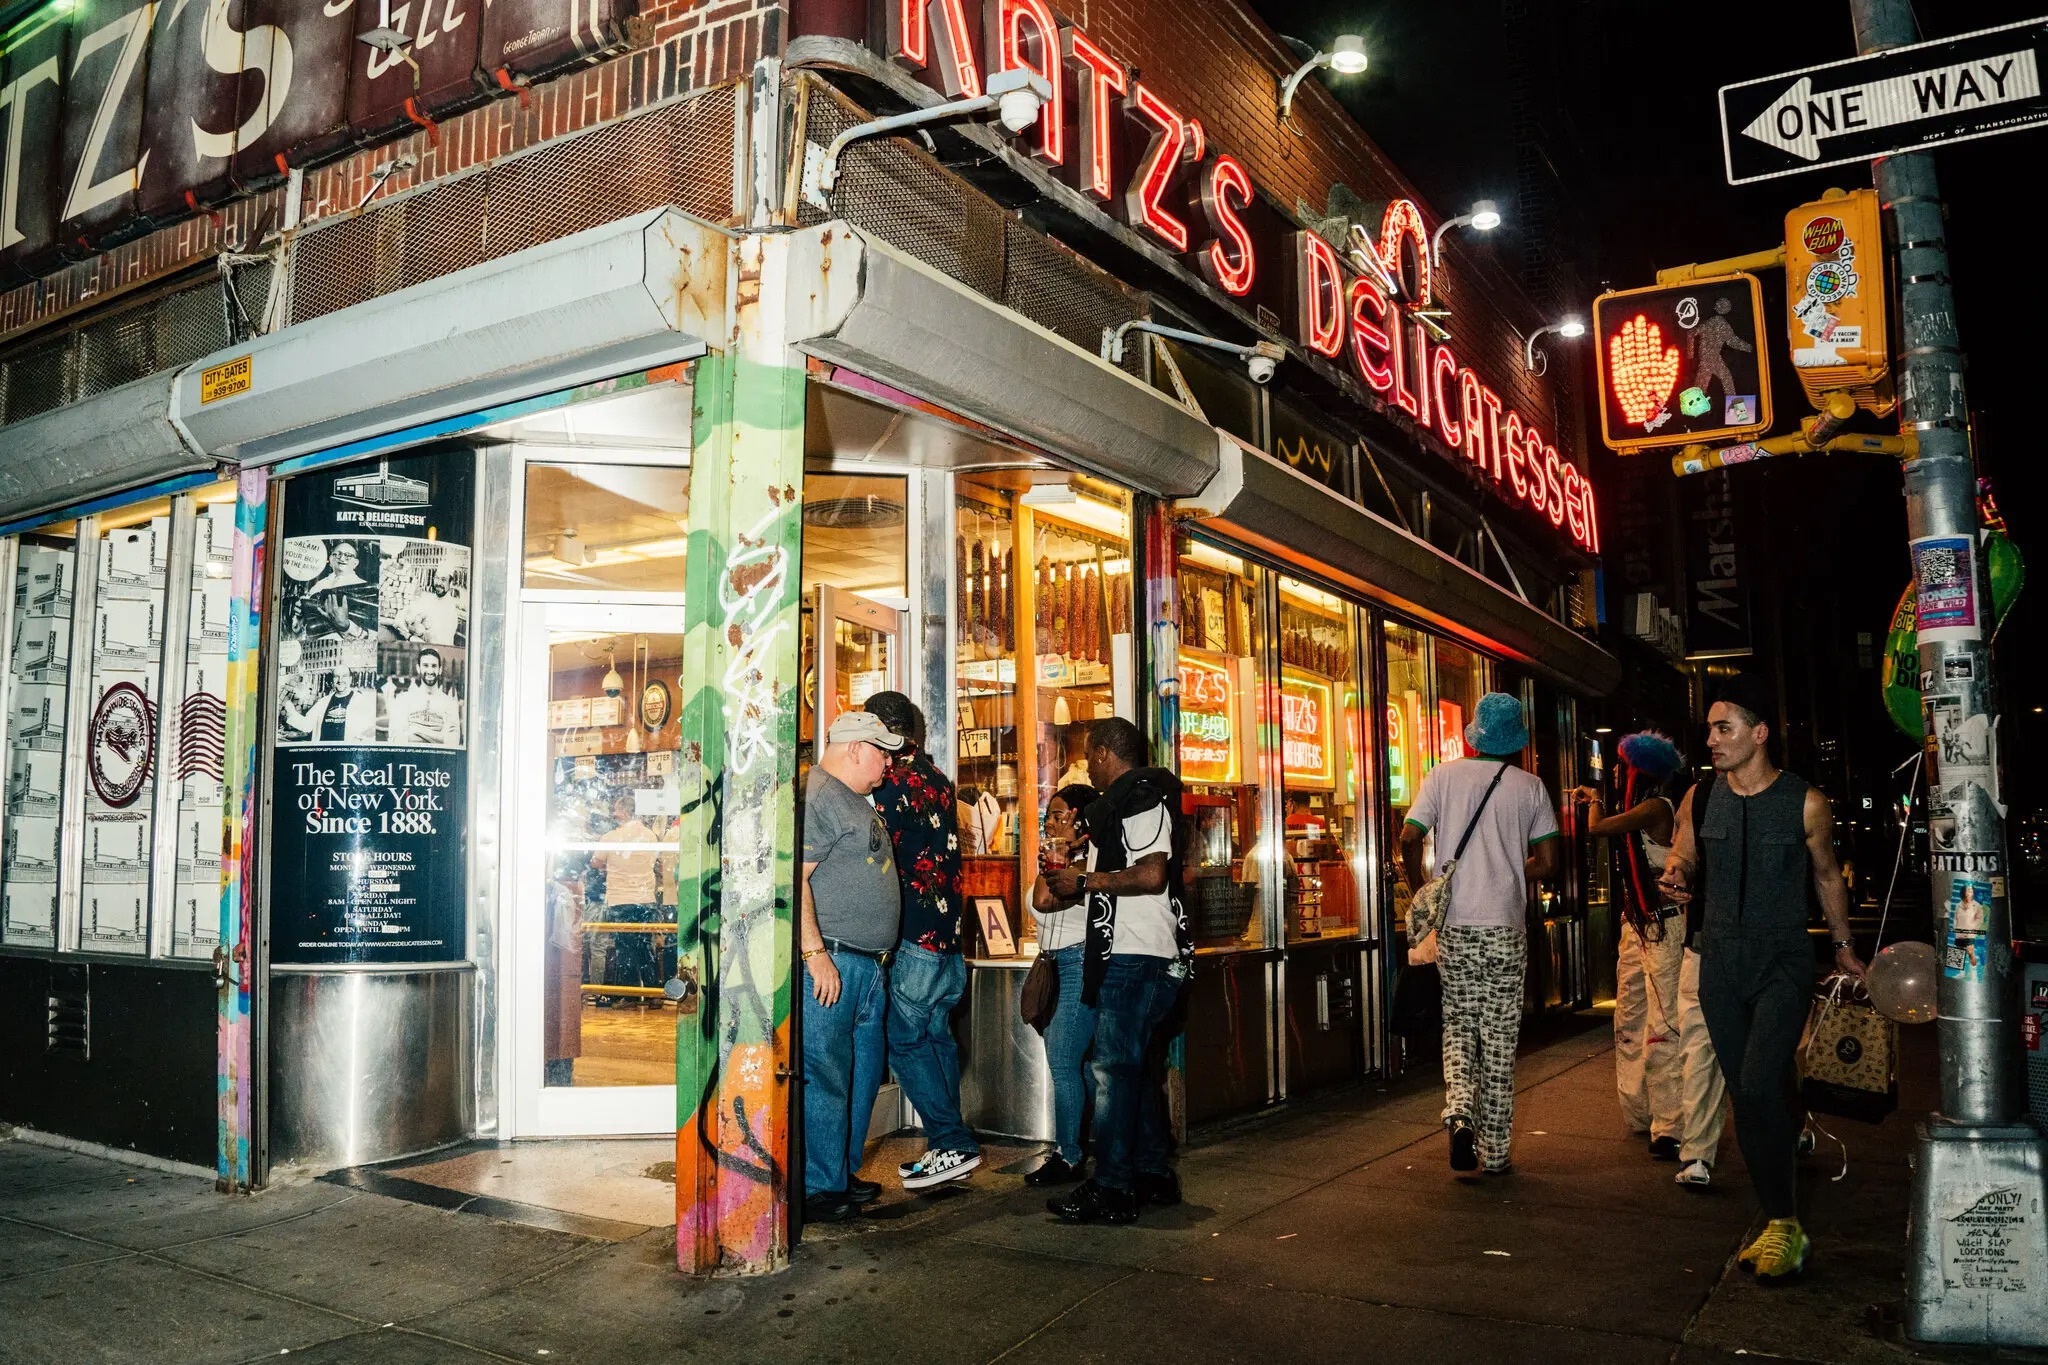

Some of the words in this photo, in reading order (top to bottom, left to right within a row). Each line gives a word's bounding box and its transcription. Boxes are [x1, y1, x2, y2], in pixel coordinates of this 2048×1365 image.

[1776, 90, 1868, 142] ONE
[1912, 58, 2014, 114] WAY
[1923, 131, 1946, 141] DEPT
[1804, 219, 1842, 240] WHAM
[1808, 234, 1838, 252] BAM
[1809, 264, 1835, 281] GLOBE
[1835, 266, 1848, 291] TOWN
[336, 511, 365, 522] KATZ'S
[366, 512, 425, 526] DELICATESSEN
[1918, 586, 1968, 606] TONERS
[1943, 598, 1966, 608] WILD
[960, 732, 989, 742] CUTTER
[648, 754, 671, 763] CUTTER
[293, 763, 336, 786] The
[341, 763, 394, 787] Real
[399, 764, 451, 788] Taste
[297, 786, 326, 811] of
[327, 787, 384, 811] New
[388, 787, 444, 812] York.
[306, 811, 372, 835] Since
[378, 811, 437, 835] 1888.
[333, 852, 371, 862] STOE
[374, 852, 412, 862] HOURS
[987, 905, 1008, 940] A
[1987, 1192, 2022, 1206] ONLY!
[1987, 1238, 2013, 1248] SLAP
[1960, 1248, 2006, 1257] LOCATIONS
